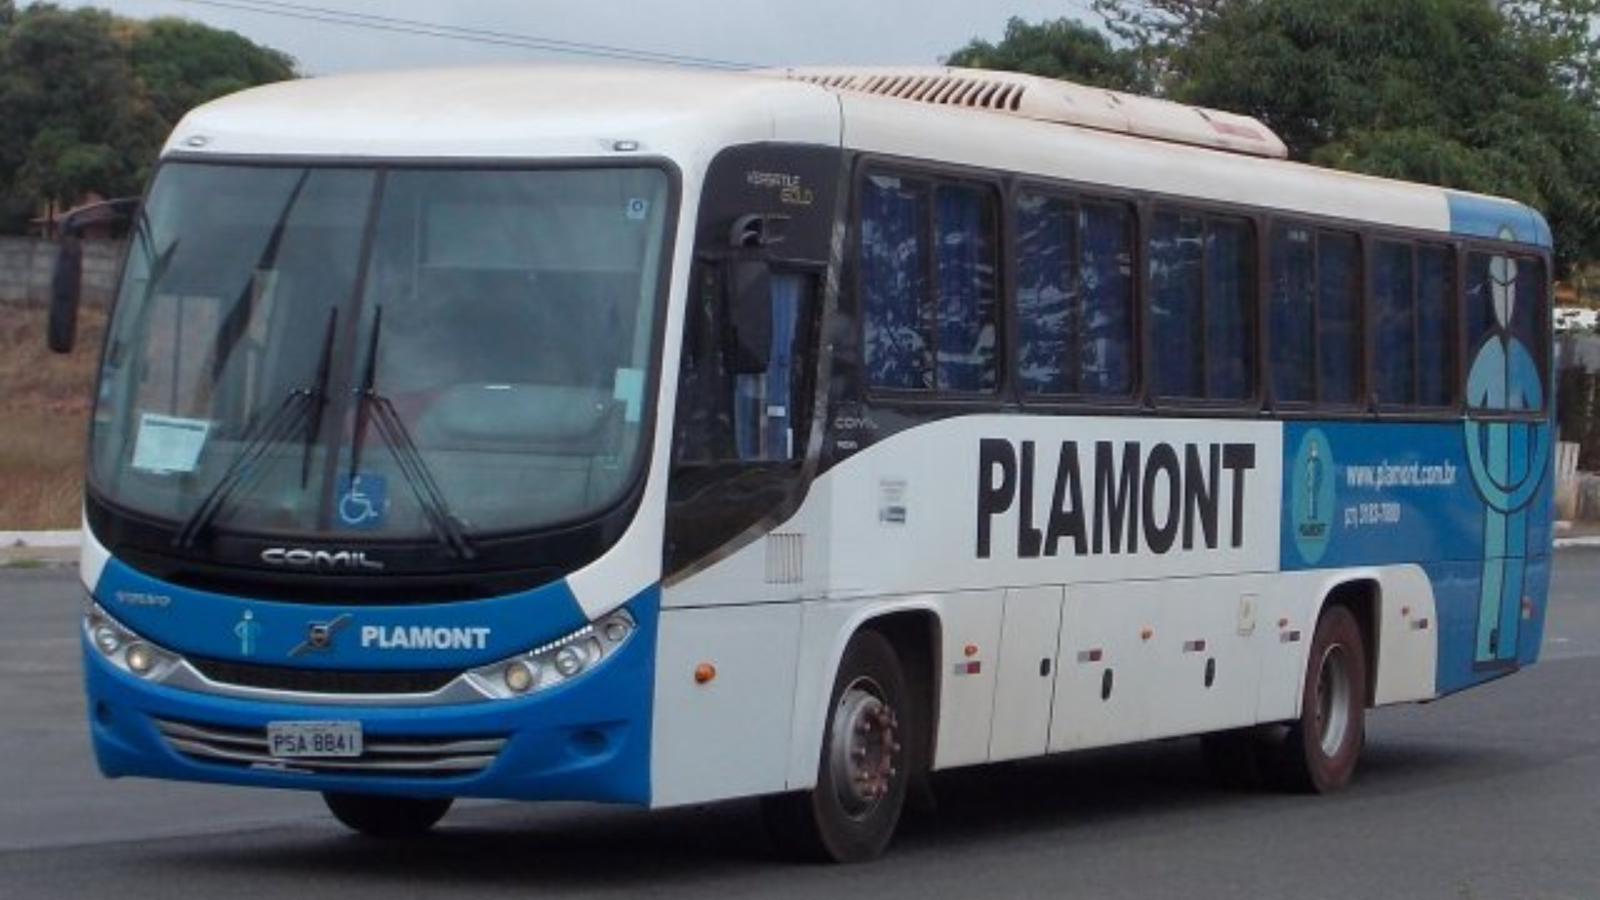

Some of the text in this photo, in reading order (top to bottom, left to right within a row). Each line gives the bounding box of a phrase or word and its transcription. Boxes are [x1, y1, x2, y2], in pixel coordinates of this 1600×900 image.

[1347, 460, 1456, 490] www.plamont.com.br
[976, 438, 1256, 559] PLAMONT
[261, 548, 384, 569] COMIL
[361, 626, 491, 650] PLAMONT
[273, 733, 308, 753] PSA
